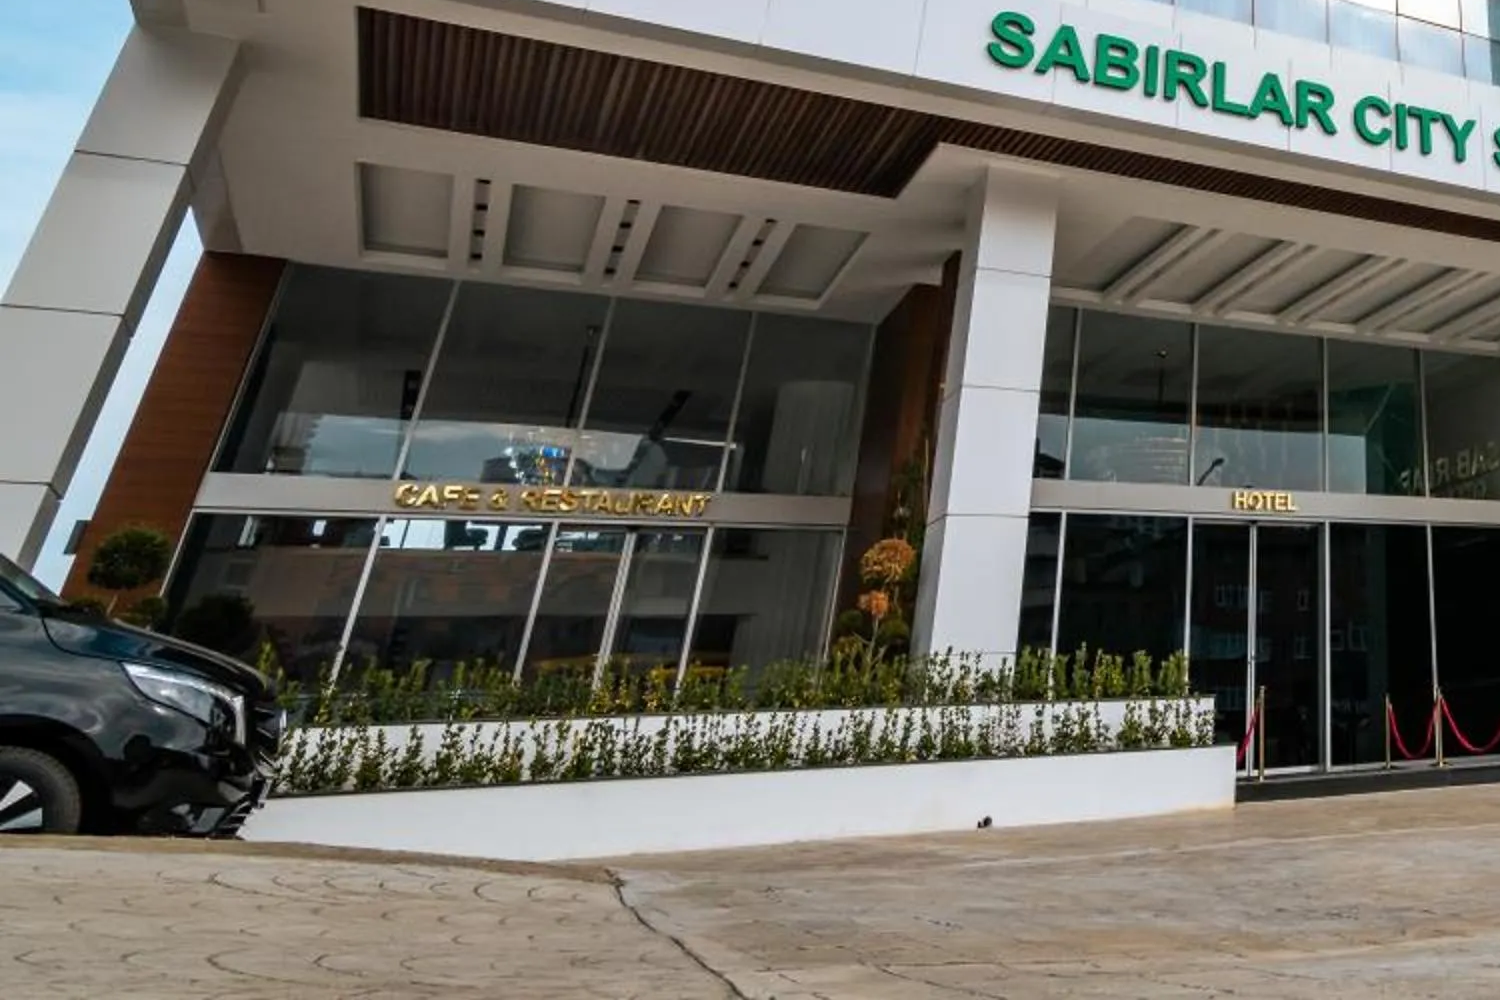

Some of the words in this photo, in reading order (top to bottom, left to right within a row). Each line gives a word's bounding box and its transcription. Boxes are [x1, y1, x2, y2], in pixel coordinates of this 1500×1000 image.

[987, 10, 1337, 136] SABIRLAR
[1353, 94, 1477, 163] CITY
[395, 483, 480, 512] CAFE
[491, 489, 510, 511] &
[520, 487, 713, 517] RESTAURANT
[1232, 490, 1299, 512] HOTEL
